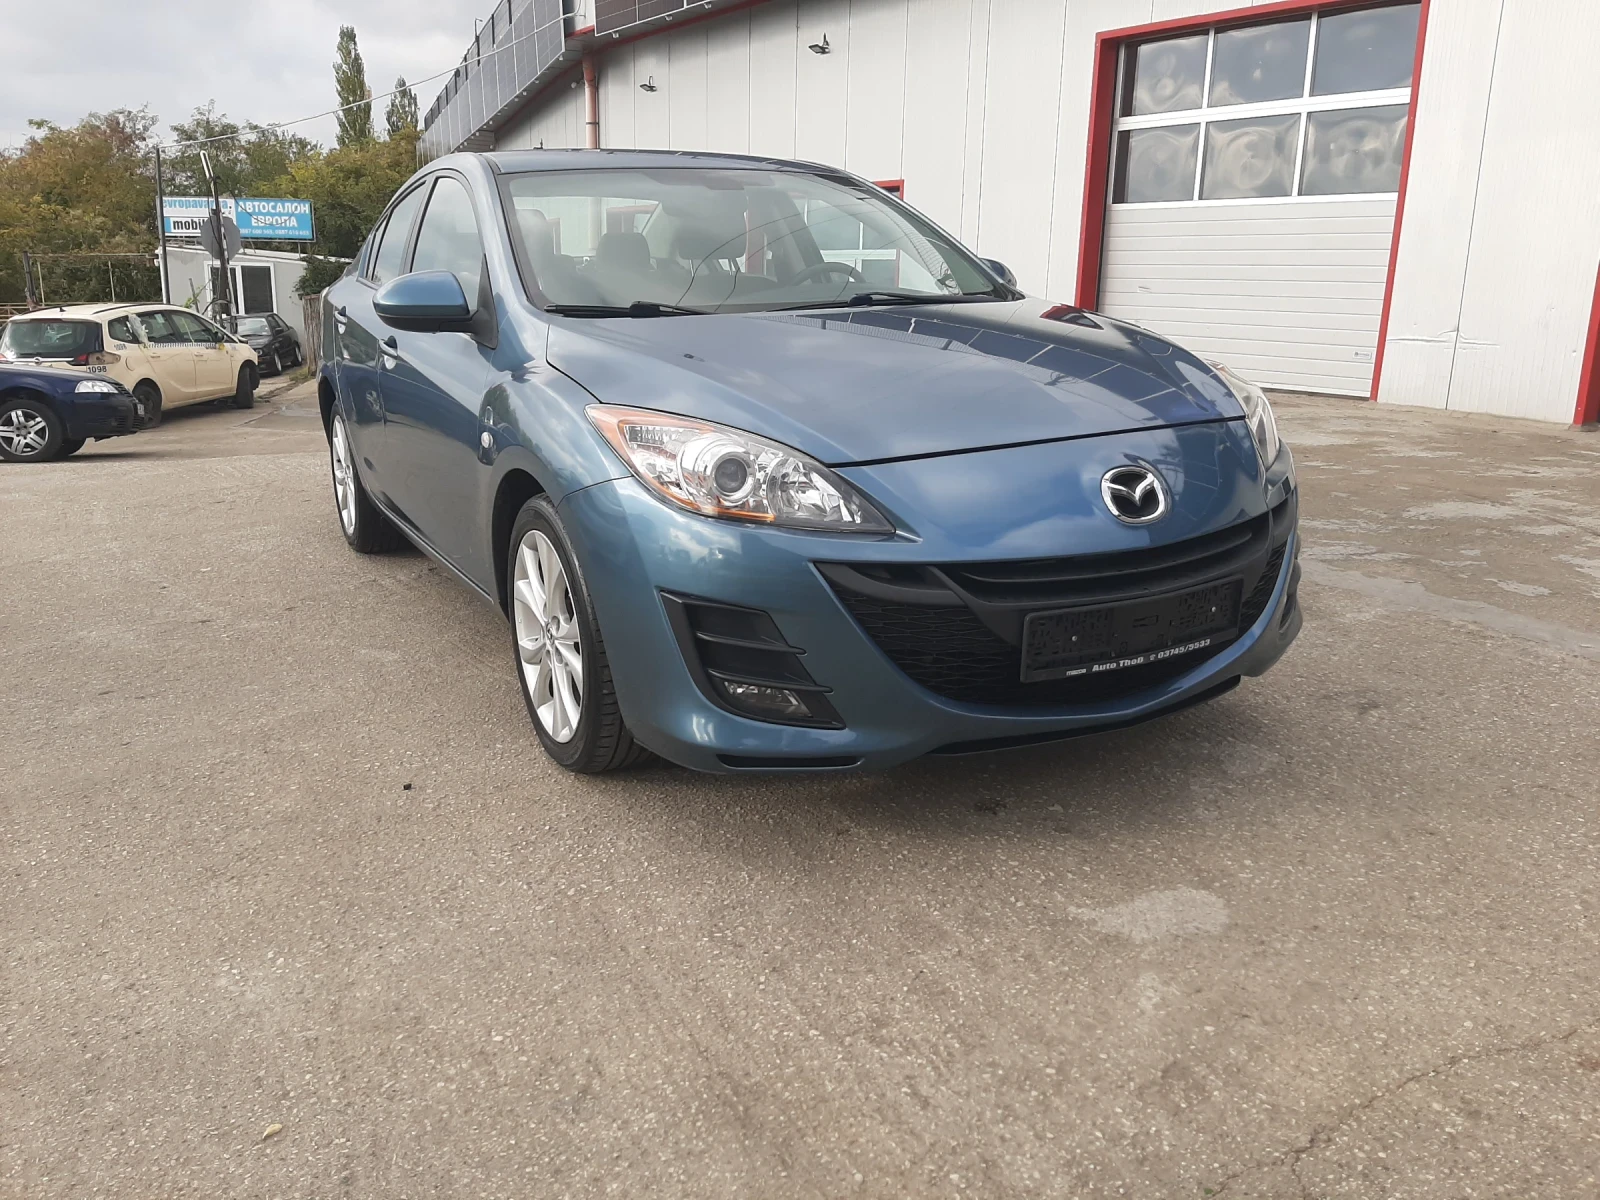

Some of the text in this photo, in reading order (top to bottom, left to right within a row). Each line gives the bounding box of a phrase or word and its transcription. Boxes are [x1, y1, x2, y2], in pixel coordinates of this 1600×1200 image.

[238, 202, 309, 214] АВТОСАЛОН
[251, 216, 297, 227] ЕВРОПА
[1092, 662, 1117, 672] Auto
